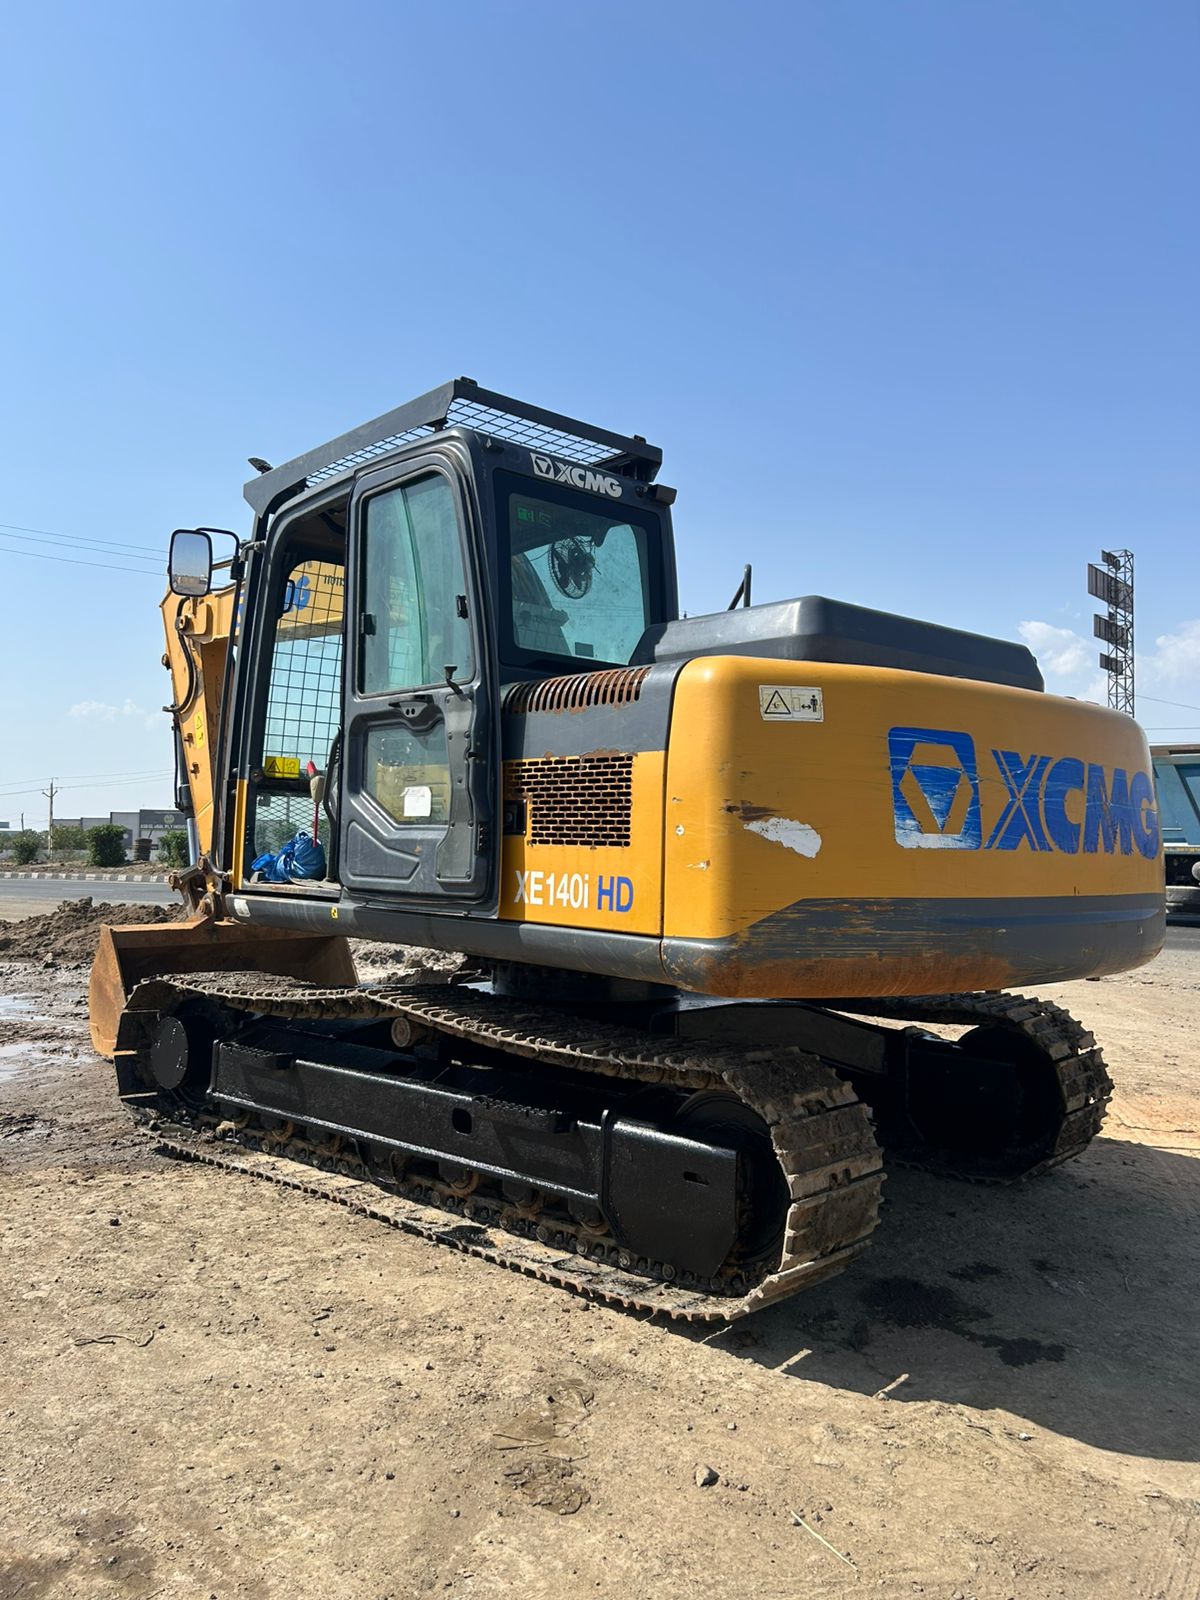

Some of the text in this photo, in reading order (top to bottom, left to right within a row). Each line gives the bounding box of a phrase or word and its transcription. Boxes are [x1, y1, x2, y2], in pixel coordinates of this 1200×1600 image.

[555, 461, 622, 498] XCMG
[984, 749, 1159, 860] XCMG
[514, 870, 634, 913] XE140i HD
